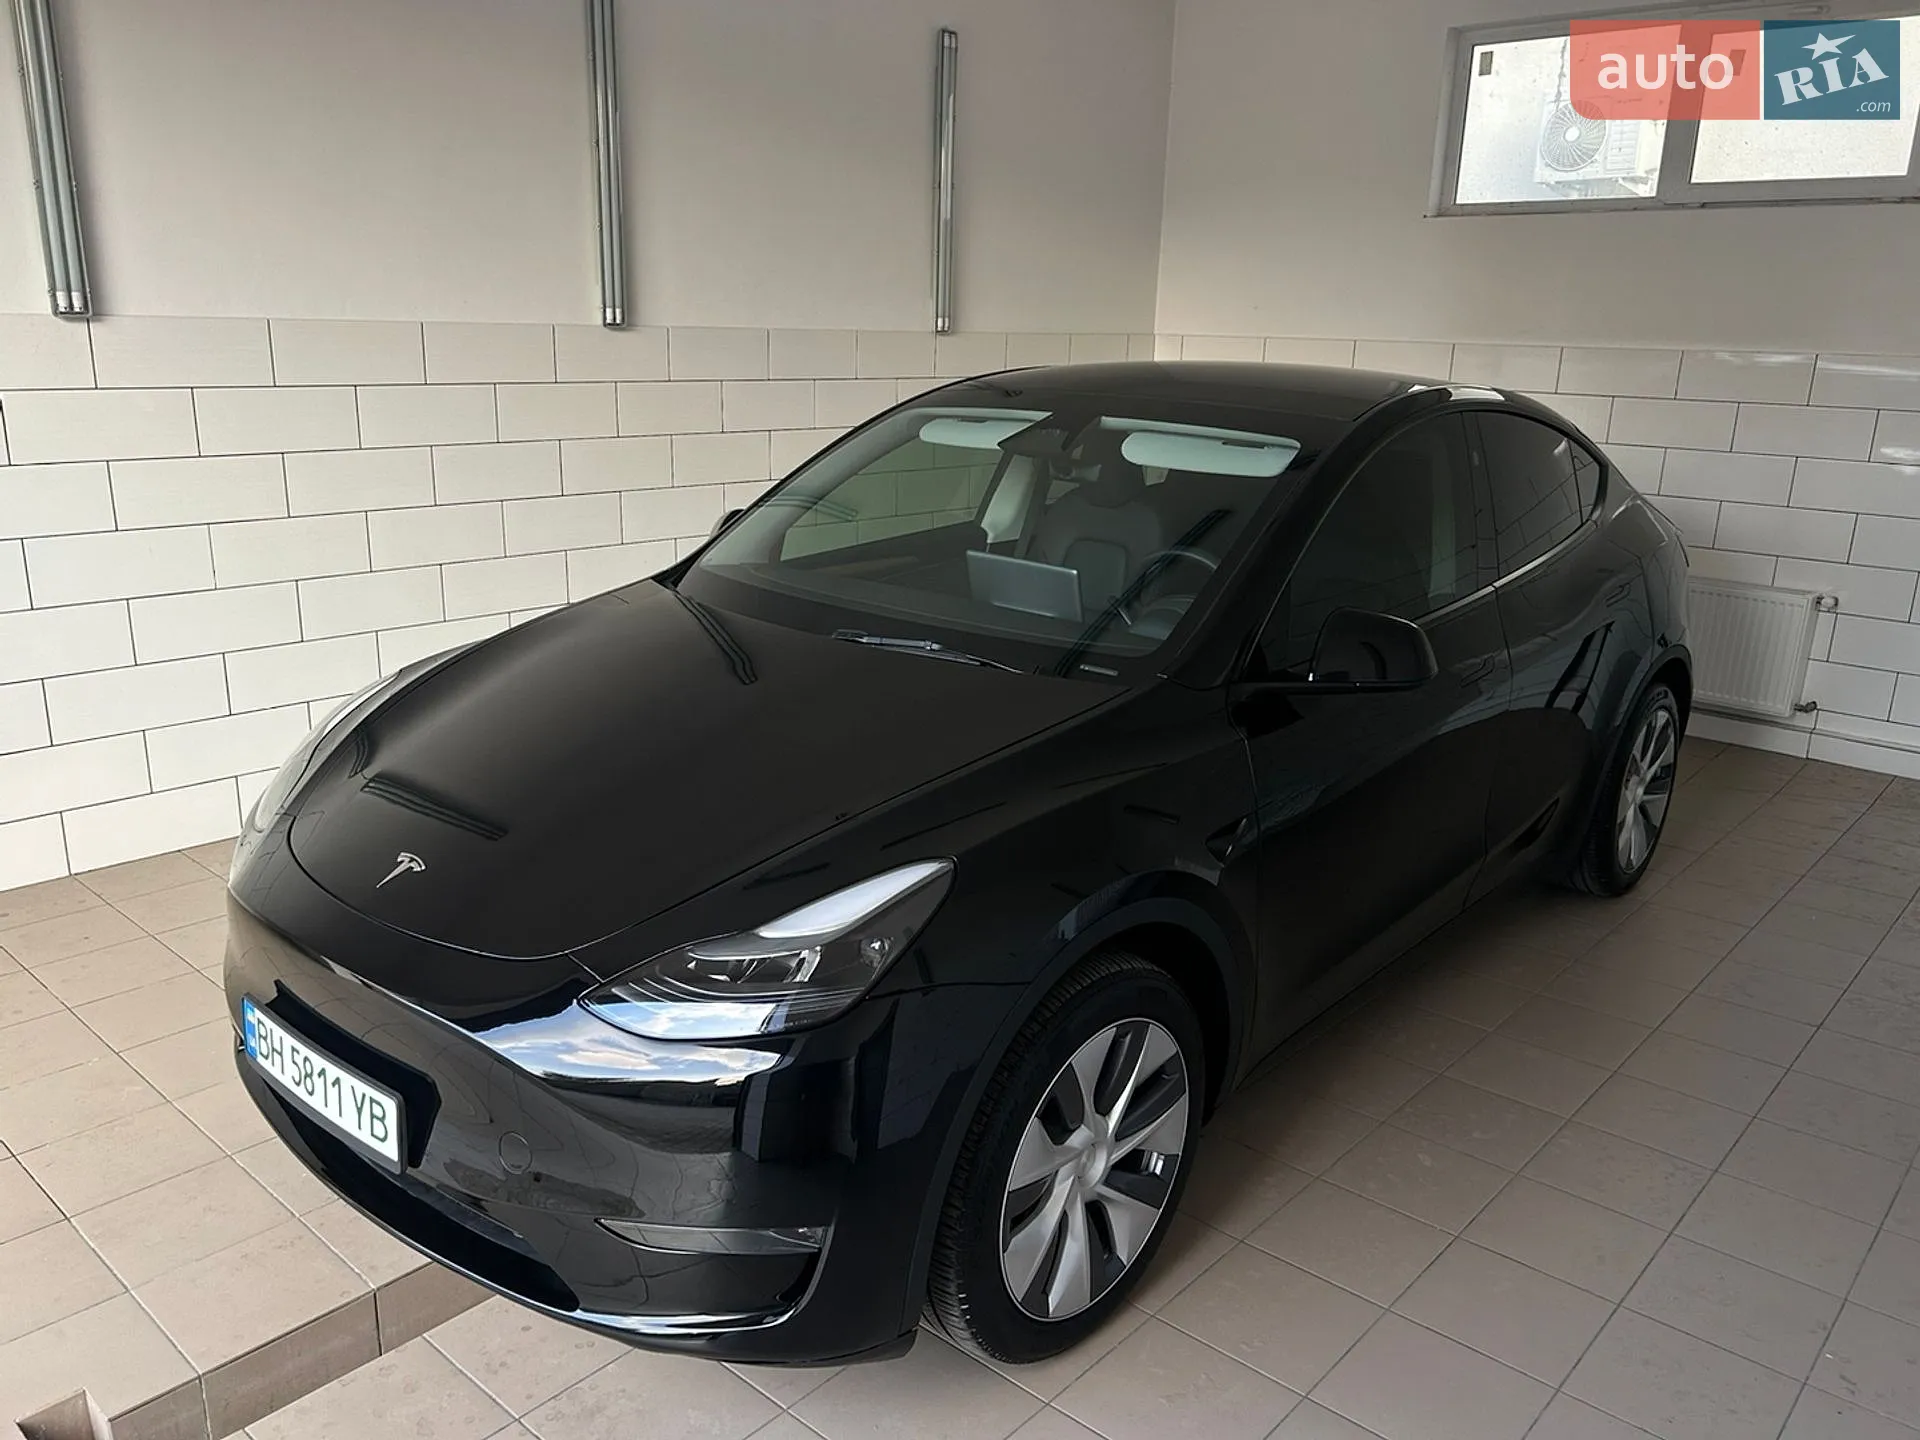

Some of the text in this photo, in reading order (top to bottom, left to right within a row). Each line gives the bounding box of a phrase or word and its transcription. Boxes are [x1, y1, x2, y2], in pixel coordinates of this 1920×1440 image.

[257, 1017, 389, 1144] BH 5811 YB
